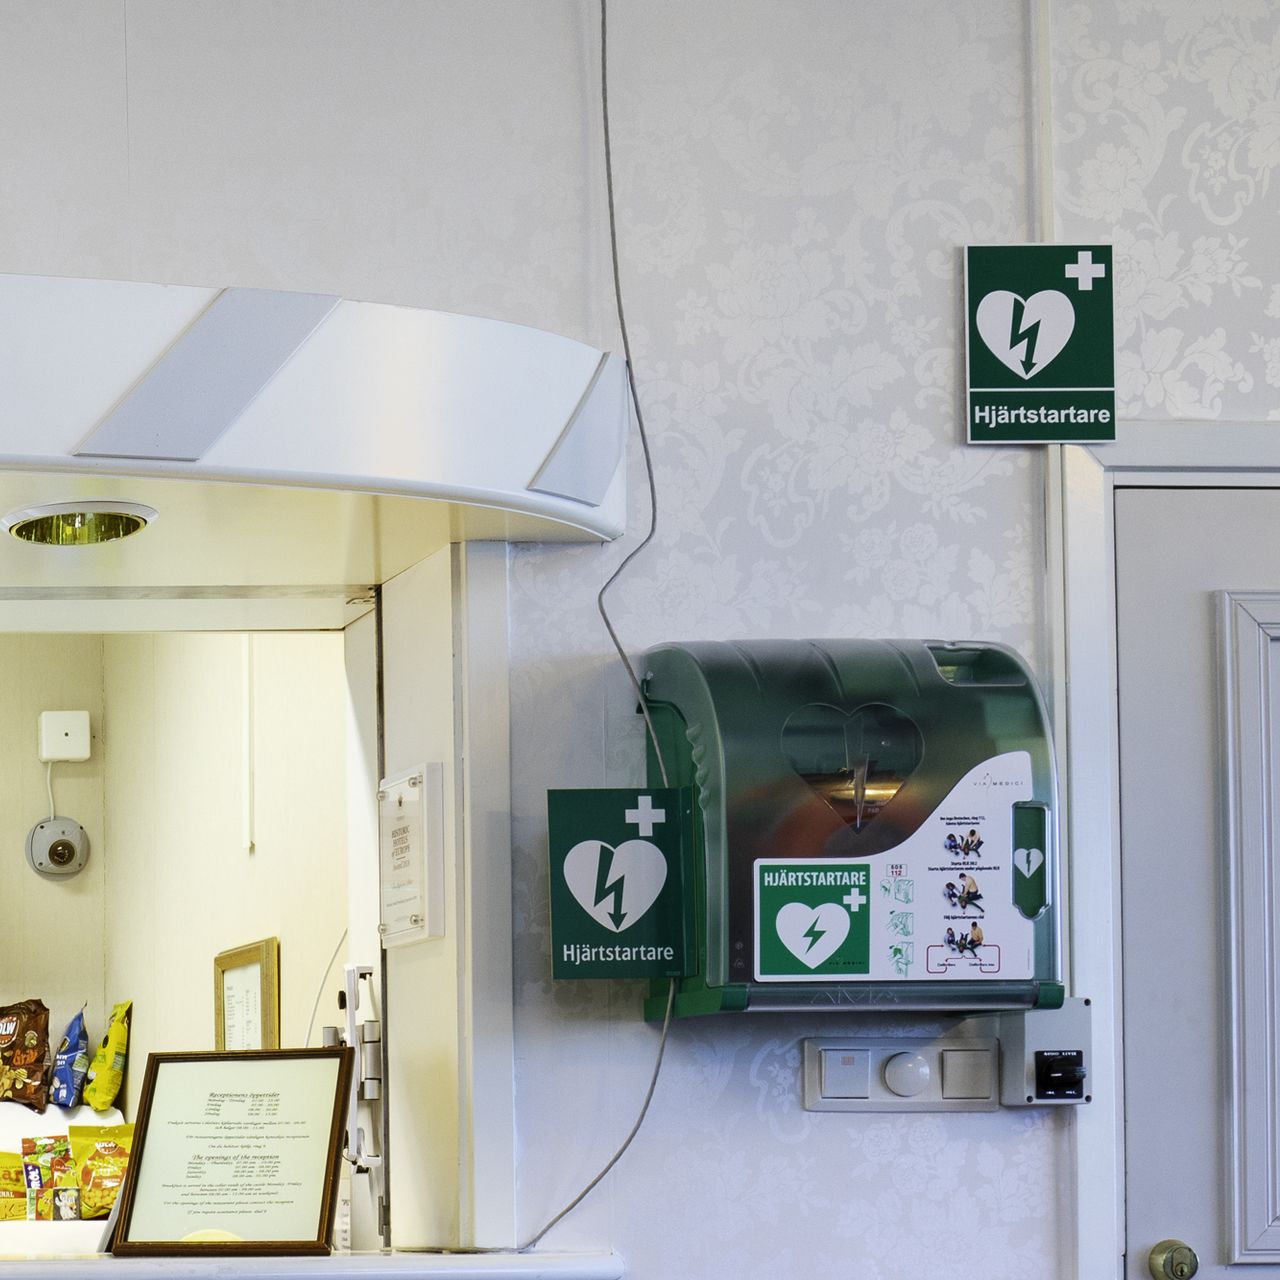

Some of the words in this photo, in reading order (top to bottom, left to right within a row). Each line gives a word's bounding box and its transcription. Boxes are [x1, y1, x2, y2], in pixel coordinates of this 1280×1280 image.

[974, 405, 1111, 428] Hjärtstartare
[764, 869, 867, 887] HJÄRTSTARTARE
[563, 944, 674, 965] Hjärtstartare
